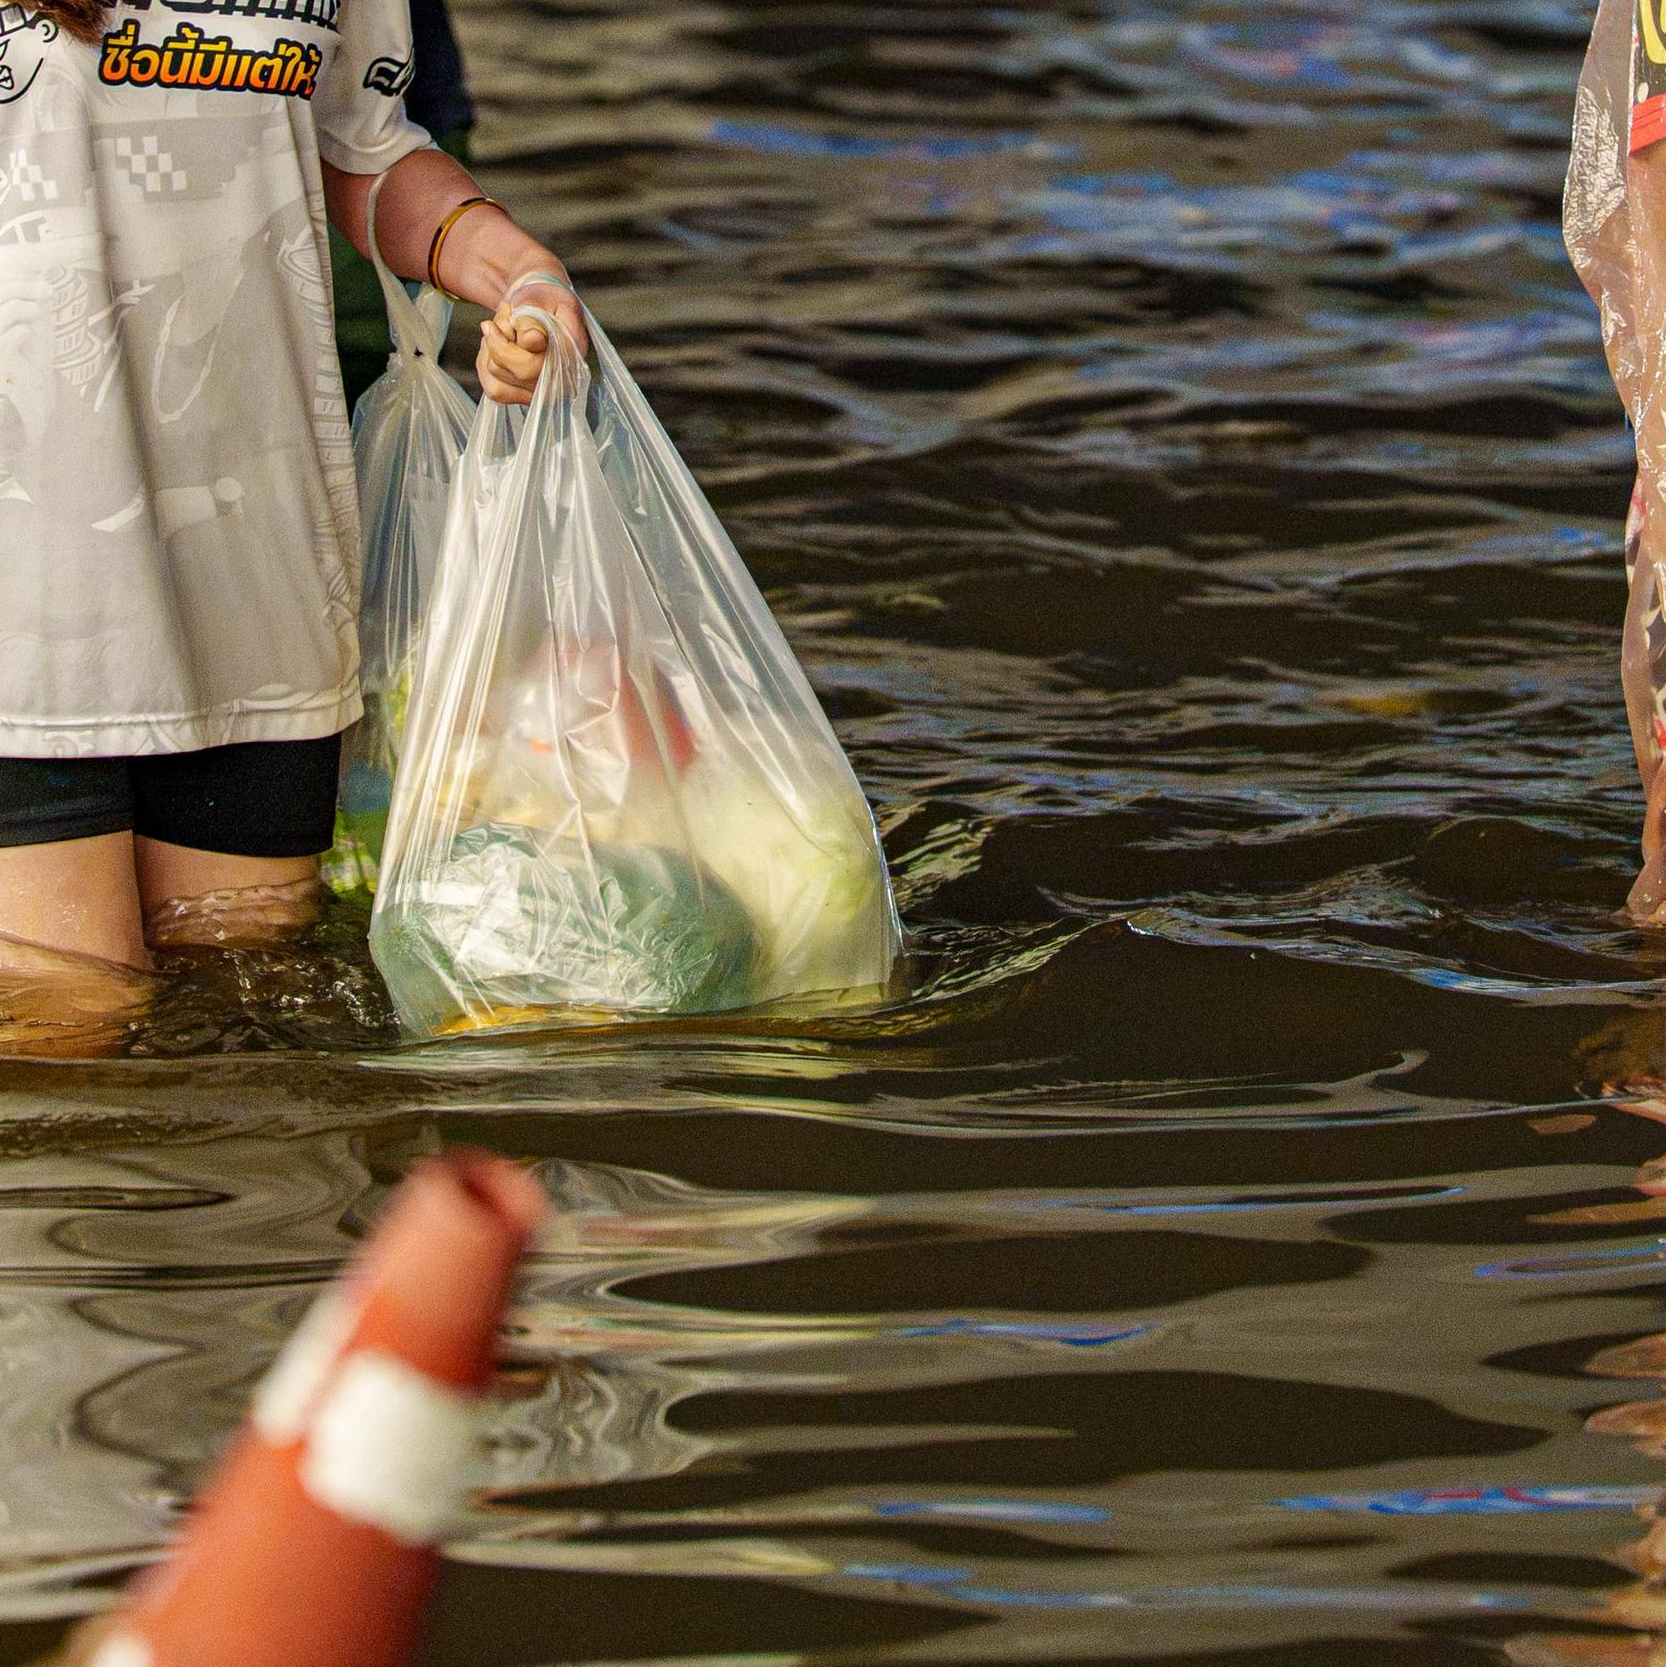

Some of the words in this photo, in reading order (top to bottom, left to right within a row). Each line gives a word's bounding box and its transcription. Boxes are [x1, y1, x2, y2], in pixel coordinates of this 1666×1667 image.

[100, 20, 321, 98] ชื่อนี้มีแต่ให้
